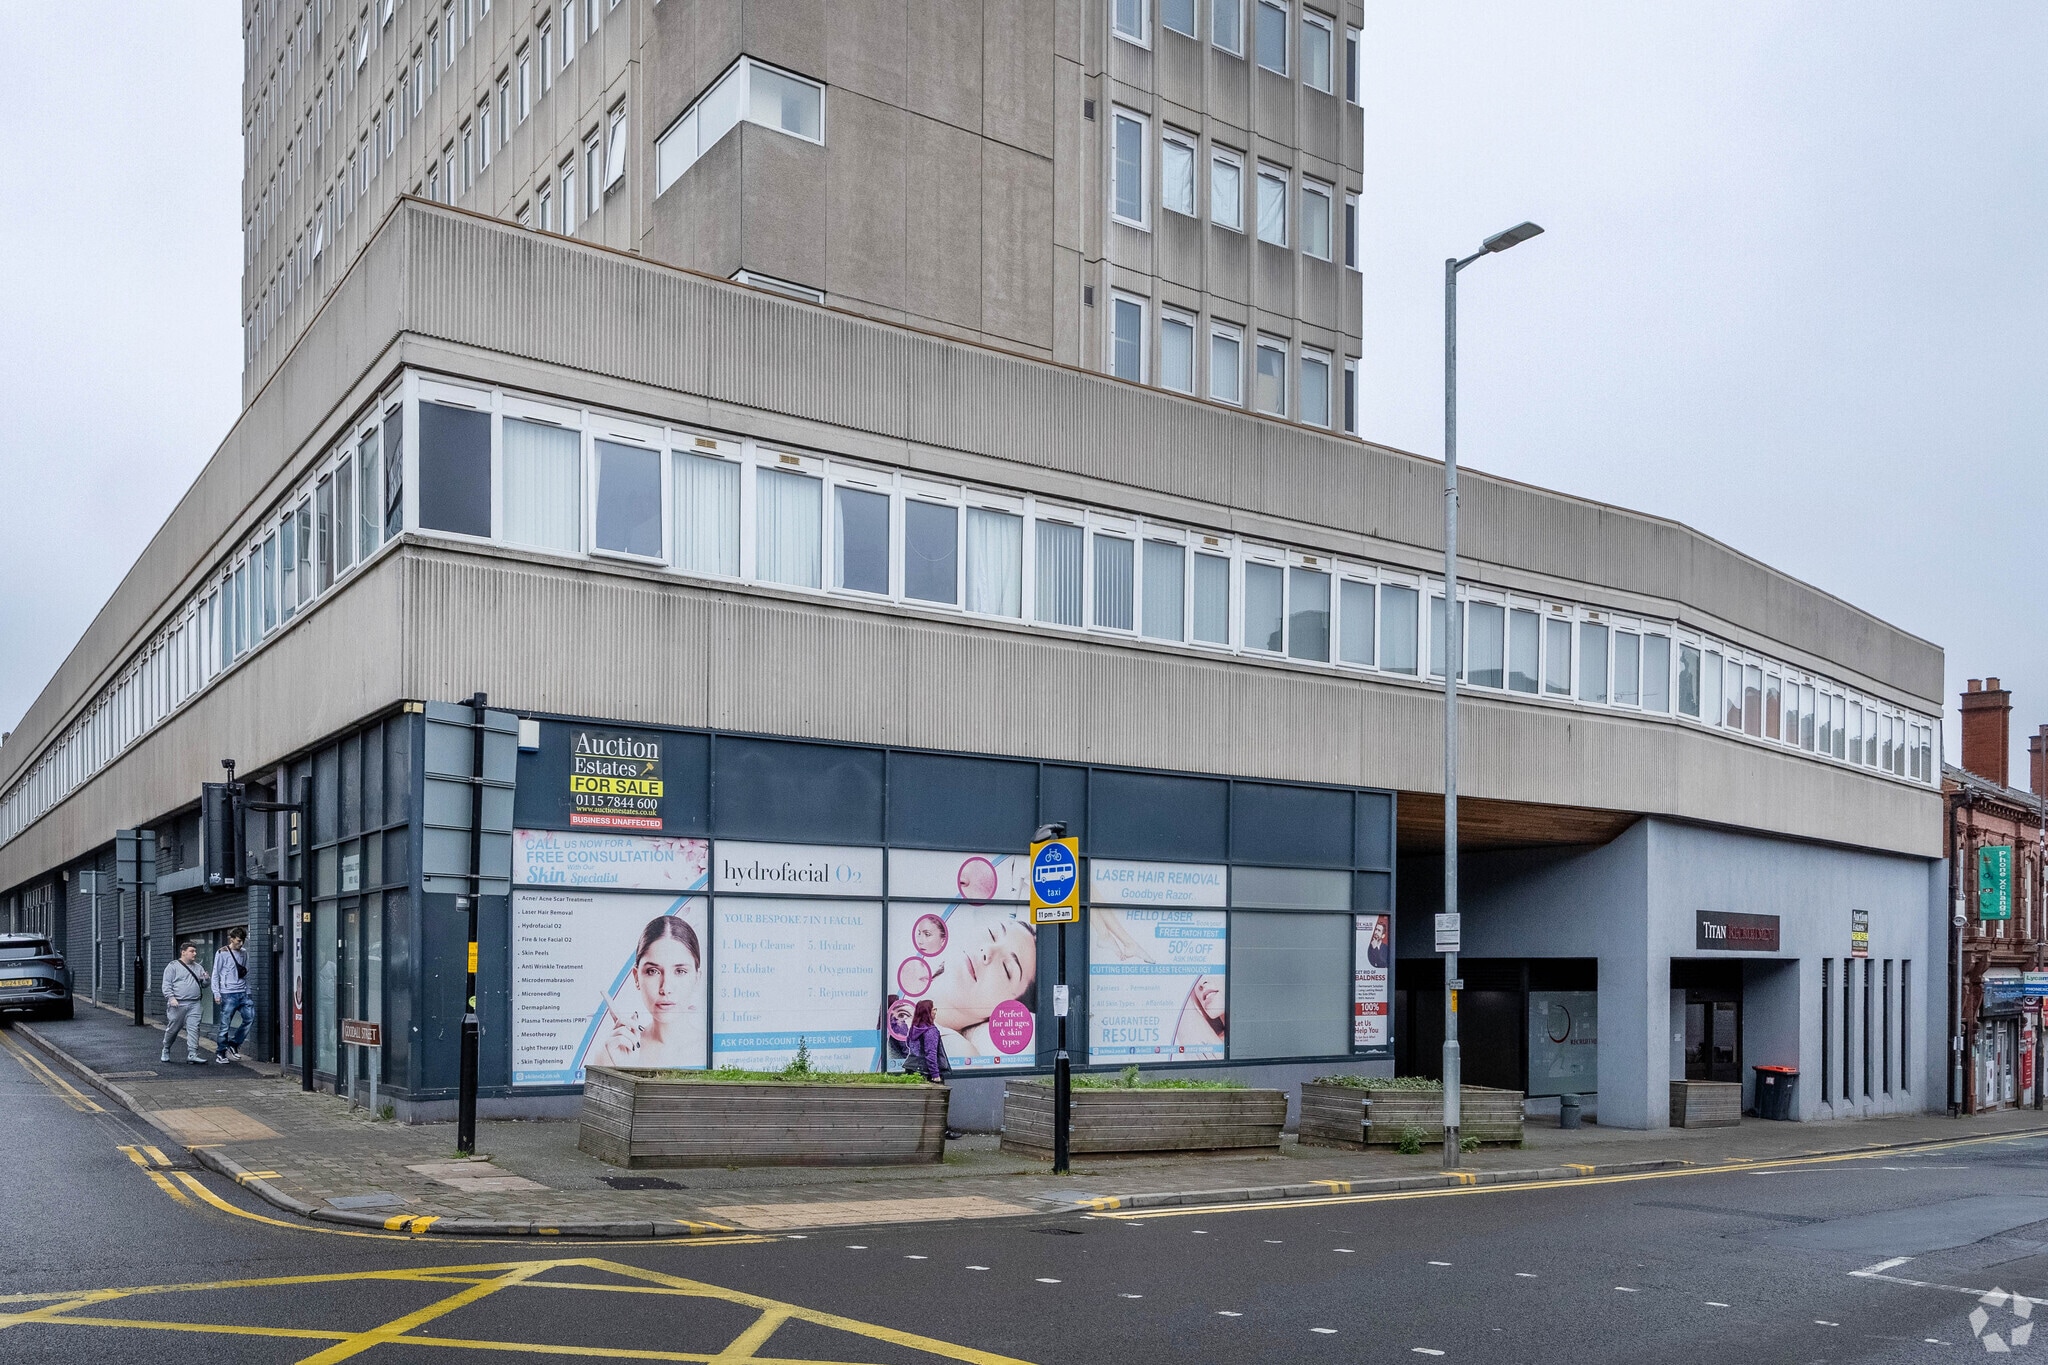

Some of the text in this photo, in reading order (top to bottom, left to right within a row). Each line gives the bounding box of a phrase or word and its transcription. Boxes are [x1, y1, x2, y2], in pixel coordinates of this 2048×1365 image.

[575, 732, 659, 759] Auction
[575, 756, 637, 777] Estates
[575, 777, 659, 795] FOR SALE
[576, 794, 658, 810] 0115 7844 600
[576, 806, 657, 816] www.auctionestates.co.uk
[572, 816, 660, 827] BUSINESS UNAFFECTED
[526, 838, 633, 850] CALL US NOW FOR A
[526, 850, 674, 863] FREE CONSULTATION
[526, 865, 619, 885] Skin Specialist
[724, 859, 830, 886] hydrofacial
[1096, 869, 1220, 885] LASER HAIR REMOVAL
[1047, 887, 1061, 897] taxi
[1121, 888, 1163, 901] Goodbye
[724, 914, 753, 924] YOUR
[755, 914, 800, 924] BESPOKE
[803, 915, 808, 924] 7
[810, 915, 821, 924] IN
[829, 916, 863, 926] FACIAL
[1043, 912, 1053, 920] pm
[1126, 910, 1193, 921] HELLO LASER
[1159, 928, 1180, 936] FREE
[733, 939, 757, 952] Deep
[760, 939, 795, 950] Cleanse
[819, 940, 856, 951] Hydrate
[1168, 941, 1213, 954] 50% OFF
[733, 963, 775, 974] Exfoliate
[819, 963, 873, 976] Oxygenation
[1092, 966, 1211, 974] CUTTING EDGE ICE LASER TECHNOLOGY
[733, 987, 760, 998] Detox
[819, 987, 869, 999] Rejuvenate
[1361, 1002, 1379, 1011] 100%
[732, 1011, 762, 1022] Infuse
[999, 1010, 1023, 1018] Perfect
[992, 1019, 1030, 1029] for all ages
[1103, 1017, 1159, 1026] GUARANTEED
[1000, 1028, 1022, 1036] & skin
[1103, 1028, 1159, 1042] RESULTS
[1355, 1027, 1368, 1035] Help
[721, 1039, 736, 1047] ASK
[739, 1038, 754, 1046] FOR
[756, 1037, 795, 1046] DISCOUNT
[1002, 1039, 1020, 1048] types
